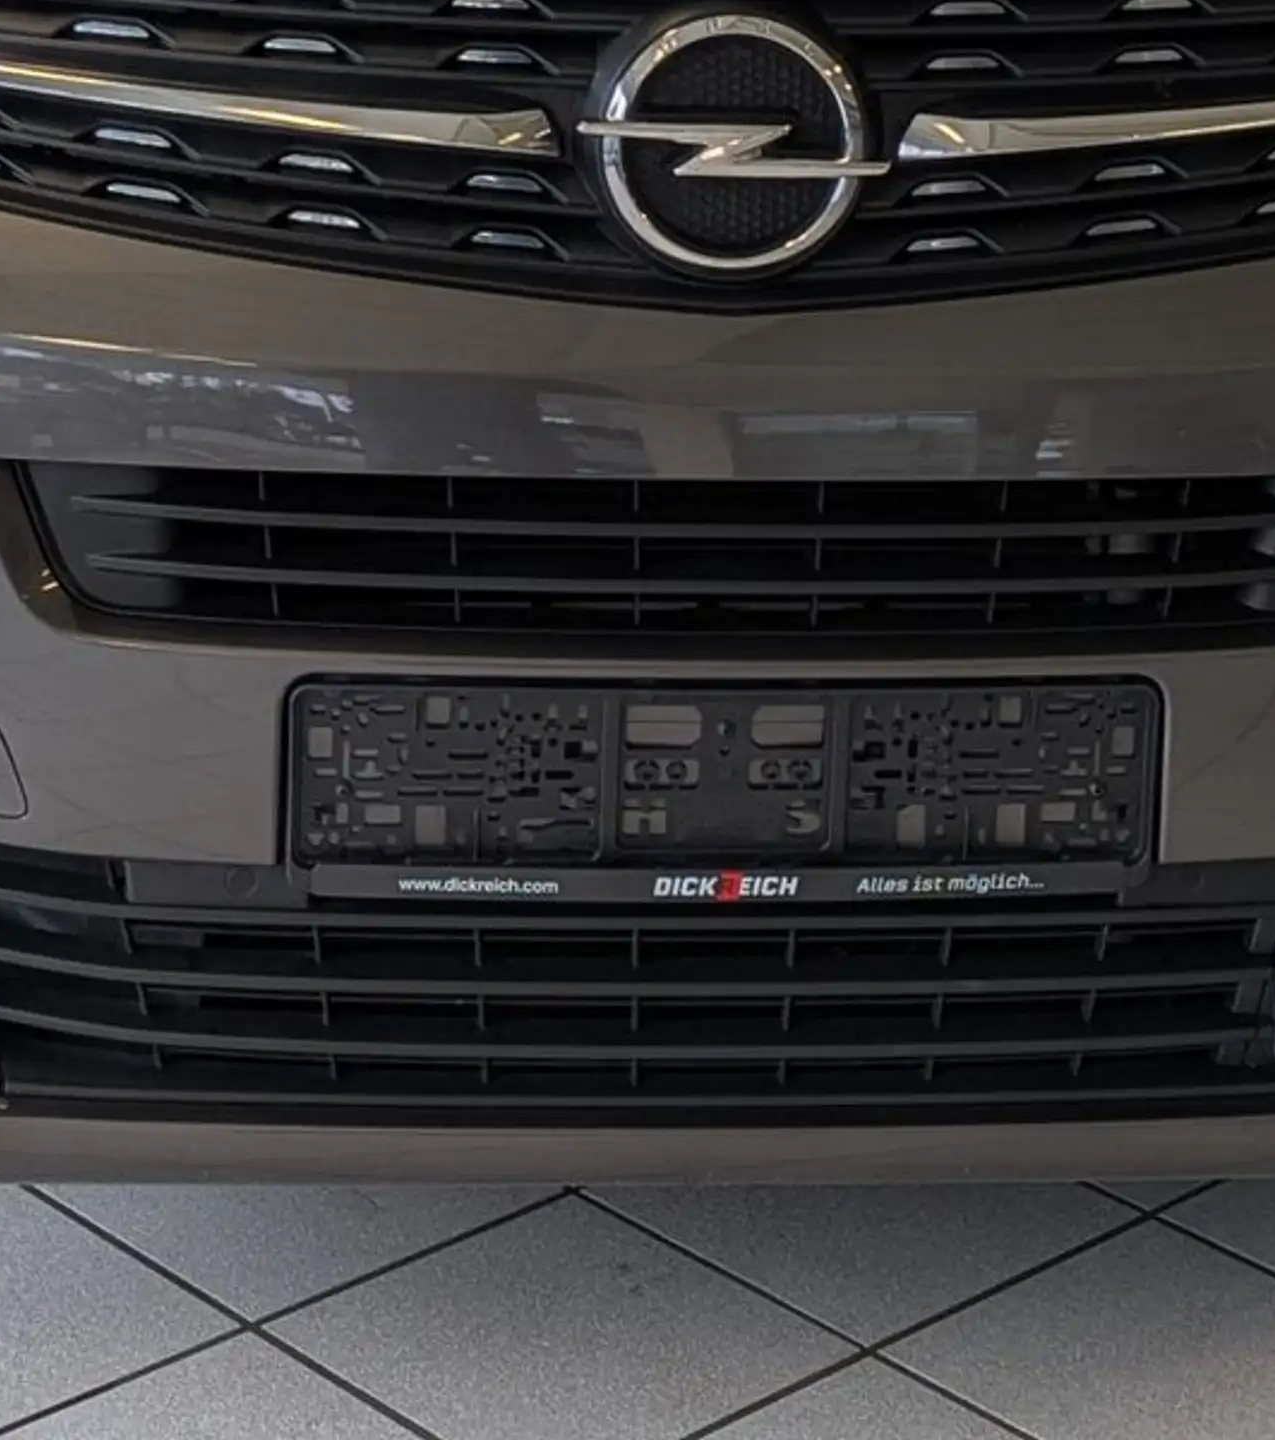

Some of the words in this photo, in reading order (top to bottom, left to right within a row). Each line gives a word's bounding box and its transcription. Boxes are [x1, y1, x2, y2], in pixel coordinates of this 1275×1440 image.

[398, 876, 559, 894] www.dickreich.com
[856, 876, 909, 894] Alles
[913, 875, 946, 892] ist
